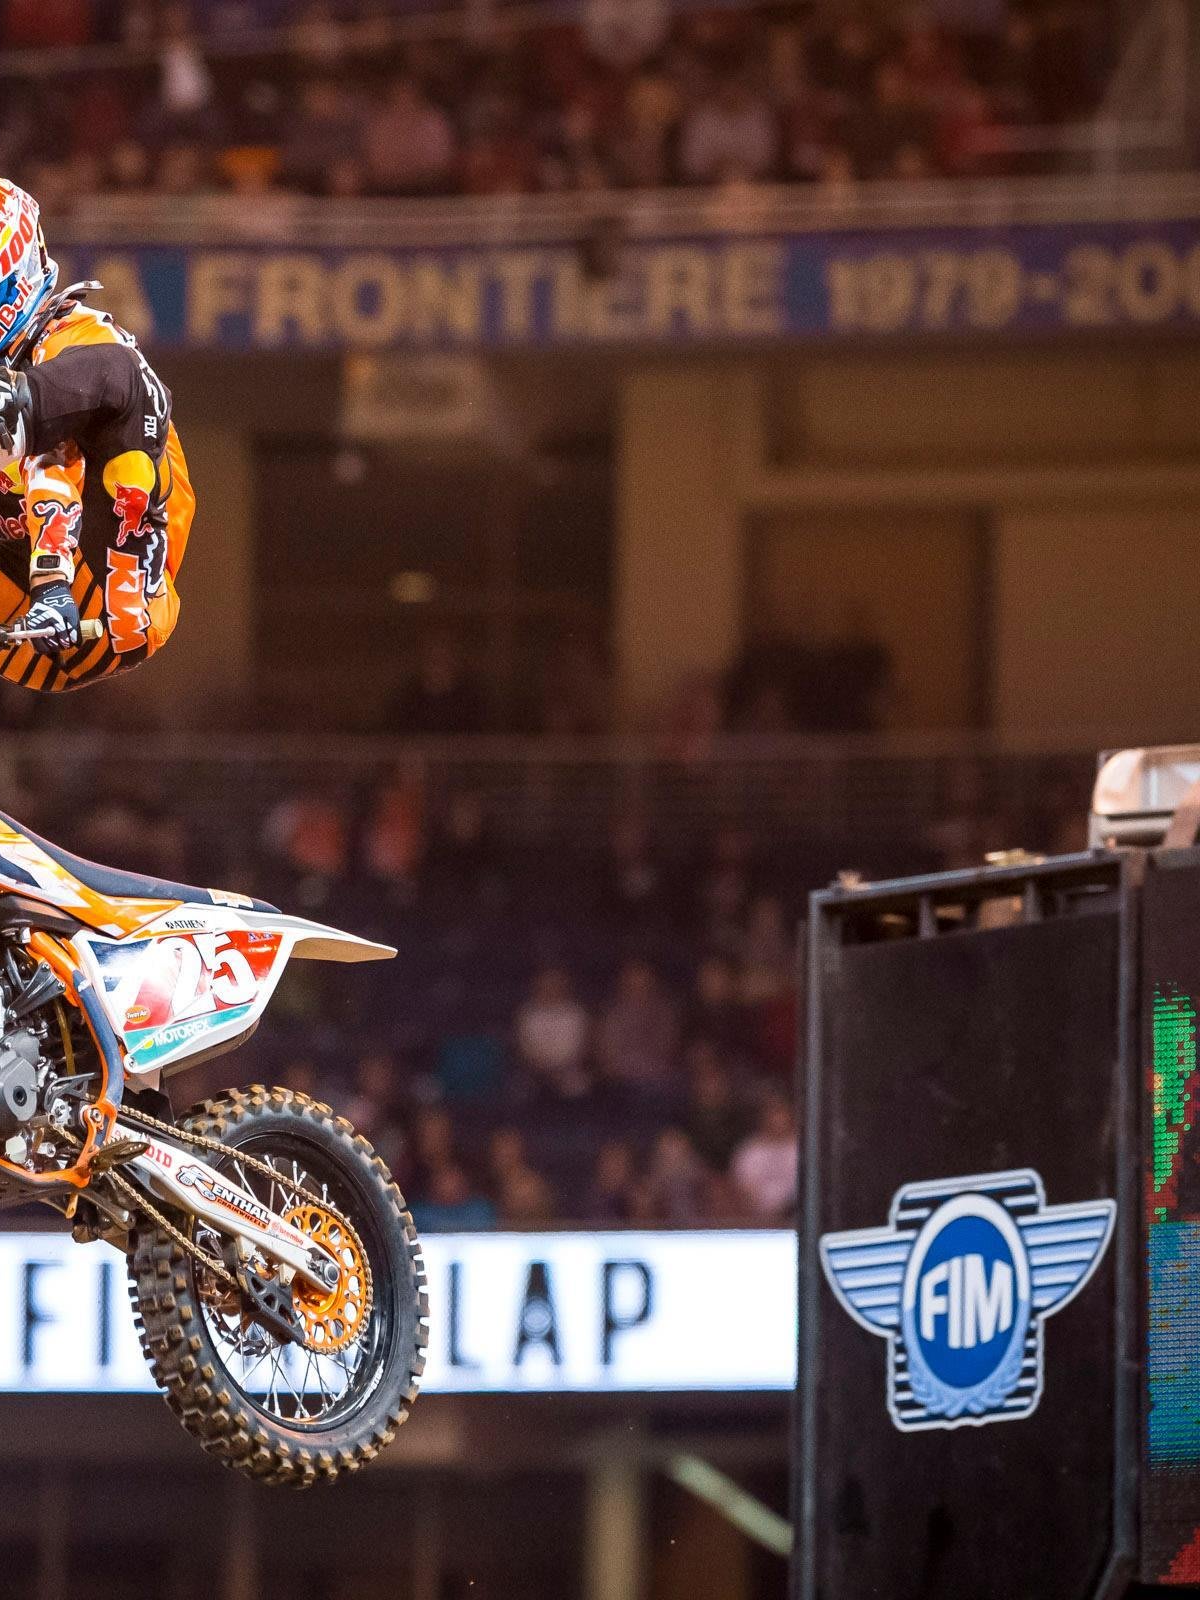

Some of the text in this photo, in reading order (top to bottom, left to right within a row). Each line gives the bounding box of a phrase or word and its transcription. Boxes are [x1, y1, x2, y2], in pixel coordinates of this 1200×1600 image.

[144, 415, 158, 439] FOX
[105, 547, 151, 654] KTM
[449, 1259, 654, 1367] LAP
[921, 1253, 1014, 1350] FIM
